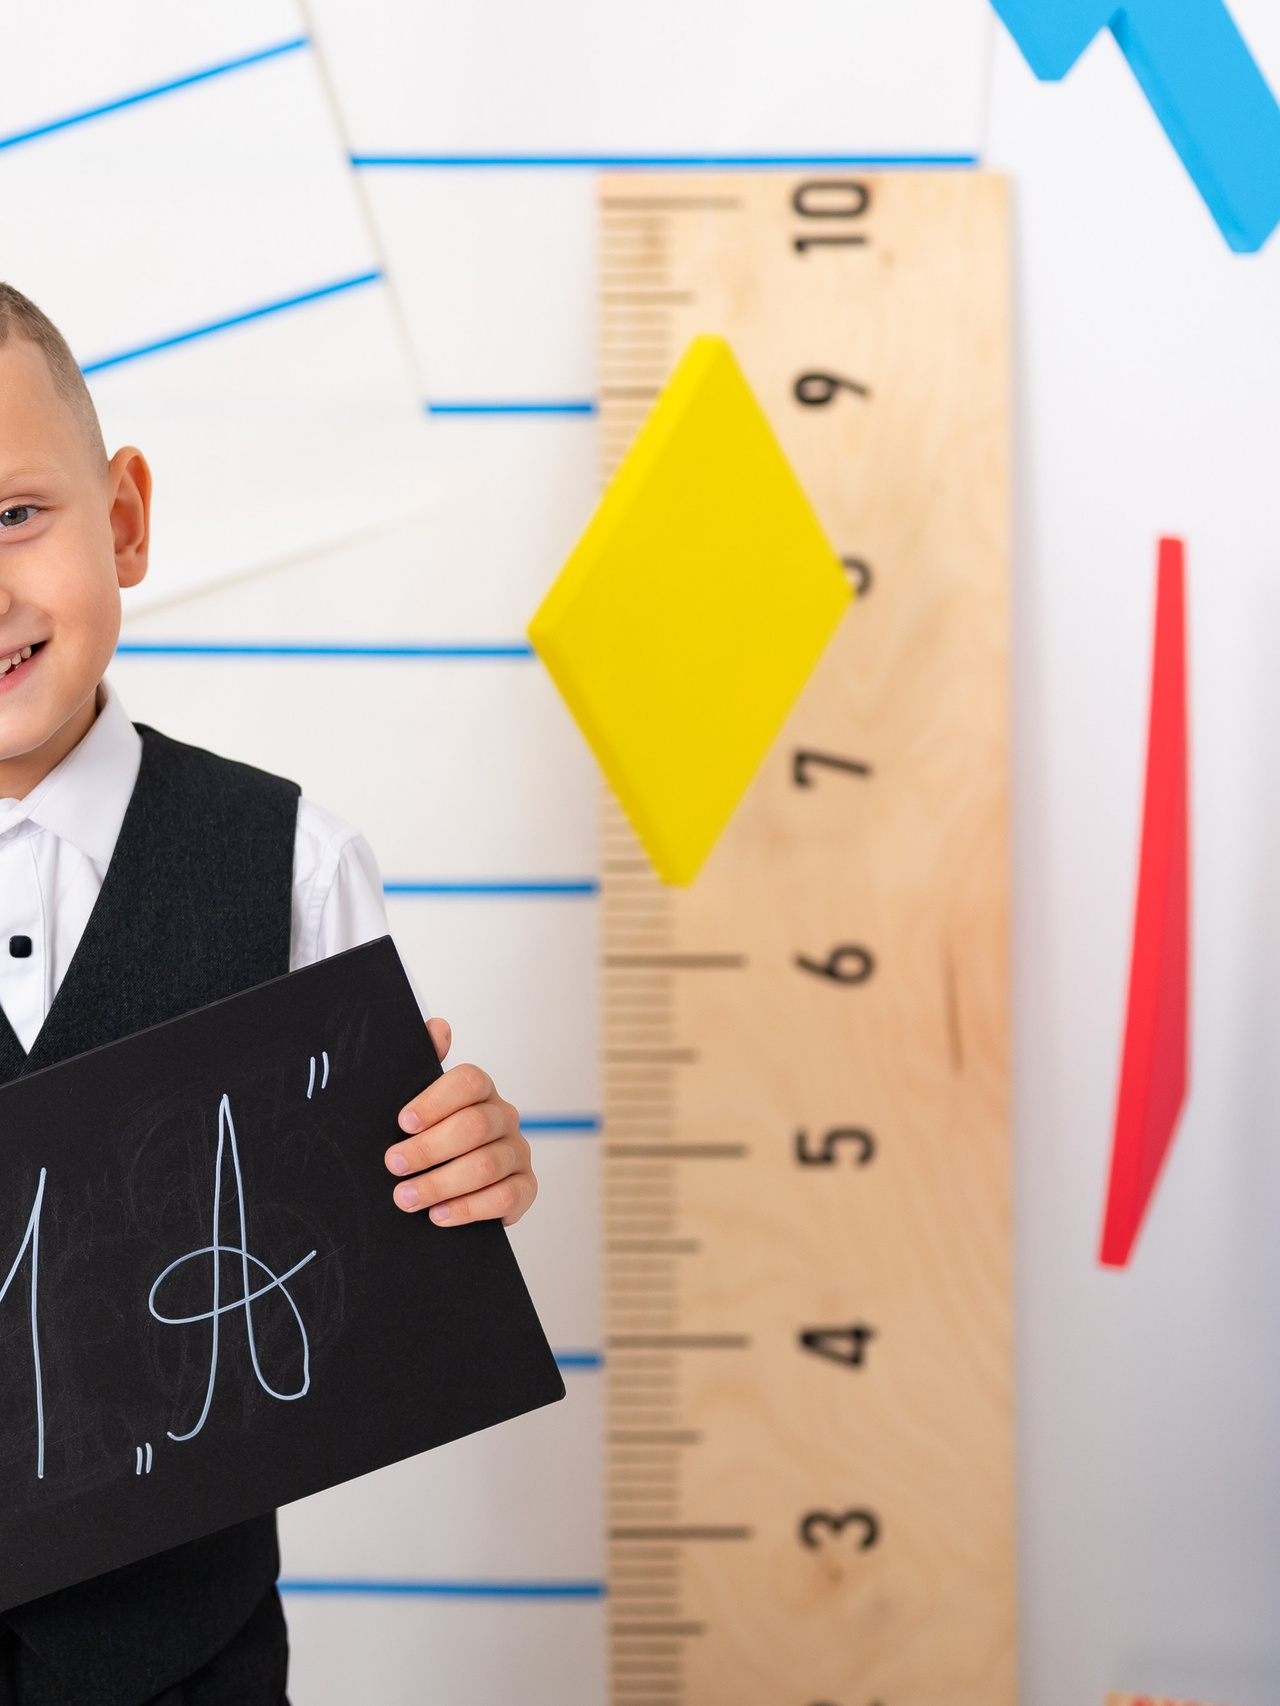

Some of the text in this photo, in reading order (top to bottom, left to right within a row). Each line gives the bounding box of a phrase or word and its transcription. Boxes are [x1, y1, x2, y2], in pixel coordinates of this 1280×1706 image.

[790, 179, 872, 257] 10
[792, 370, 871, 410] 9
[792, 748, 872, 789] 7
[793, 943, 876, 987] 6
[794, 1126, 876, 1168] 5
[797, 1323, 876, 1370] 4
[798, 1508, 880, 1552] 3
